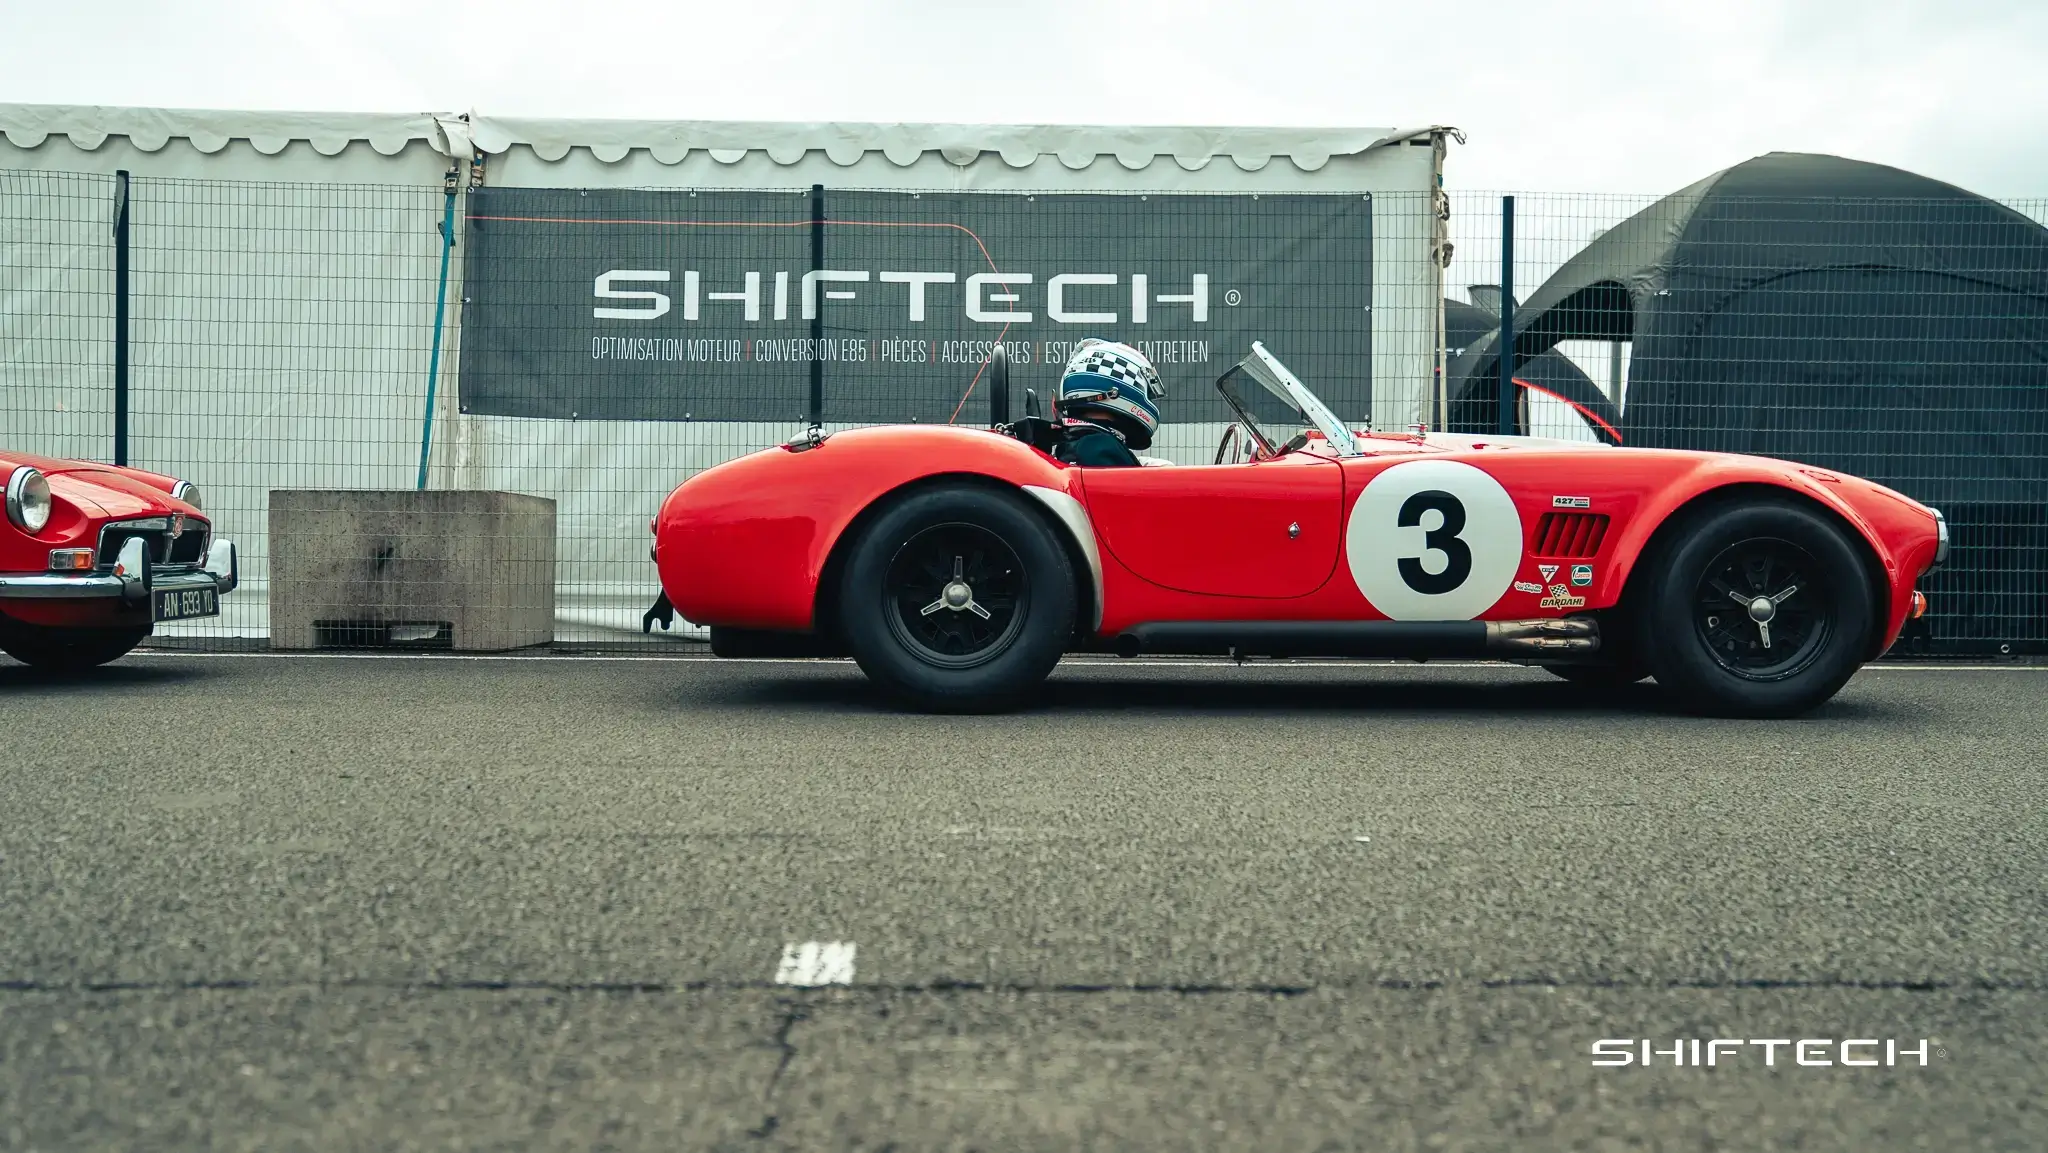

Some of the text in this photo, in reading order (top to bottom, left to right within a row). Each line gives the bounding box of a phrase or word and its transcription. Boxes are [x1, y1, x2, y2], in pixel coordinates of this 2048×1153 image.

[593, 270, 1209, 322] SHIFTECH
[591, 336, 683, 361] OPTIMISATION
[687, 339, 741, 362] MOTEUR
[755, 338, 837, 362] CONVERSION
[841, 339, 867, 362] E85
[881, 335, 927, 363] PIÈCES
[941, 340, 1031, 364] ACCESSRES
[1554, 497, 1574, 505] 427
[1397, 489, 1472, 595] 3
[163, 592, 179, 618] AN
[182, 590, 201, 616] 693
[1541, 598, 1584, 609] BARDAHL
